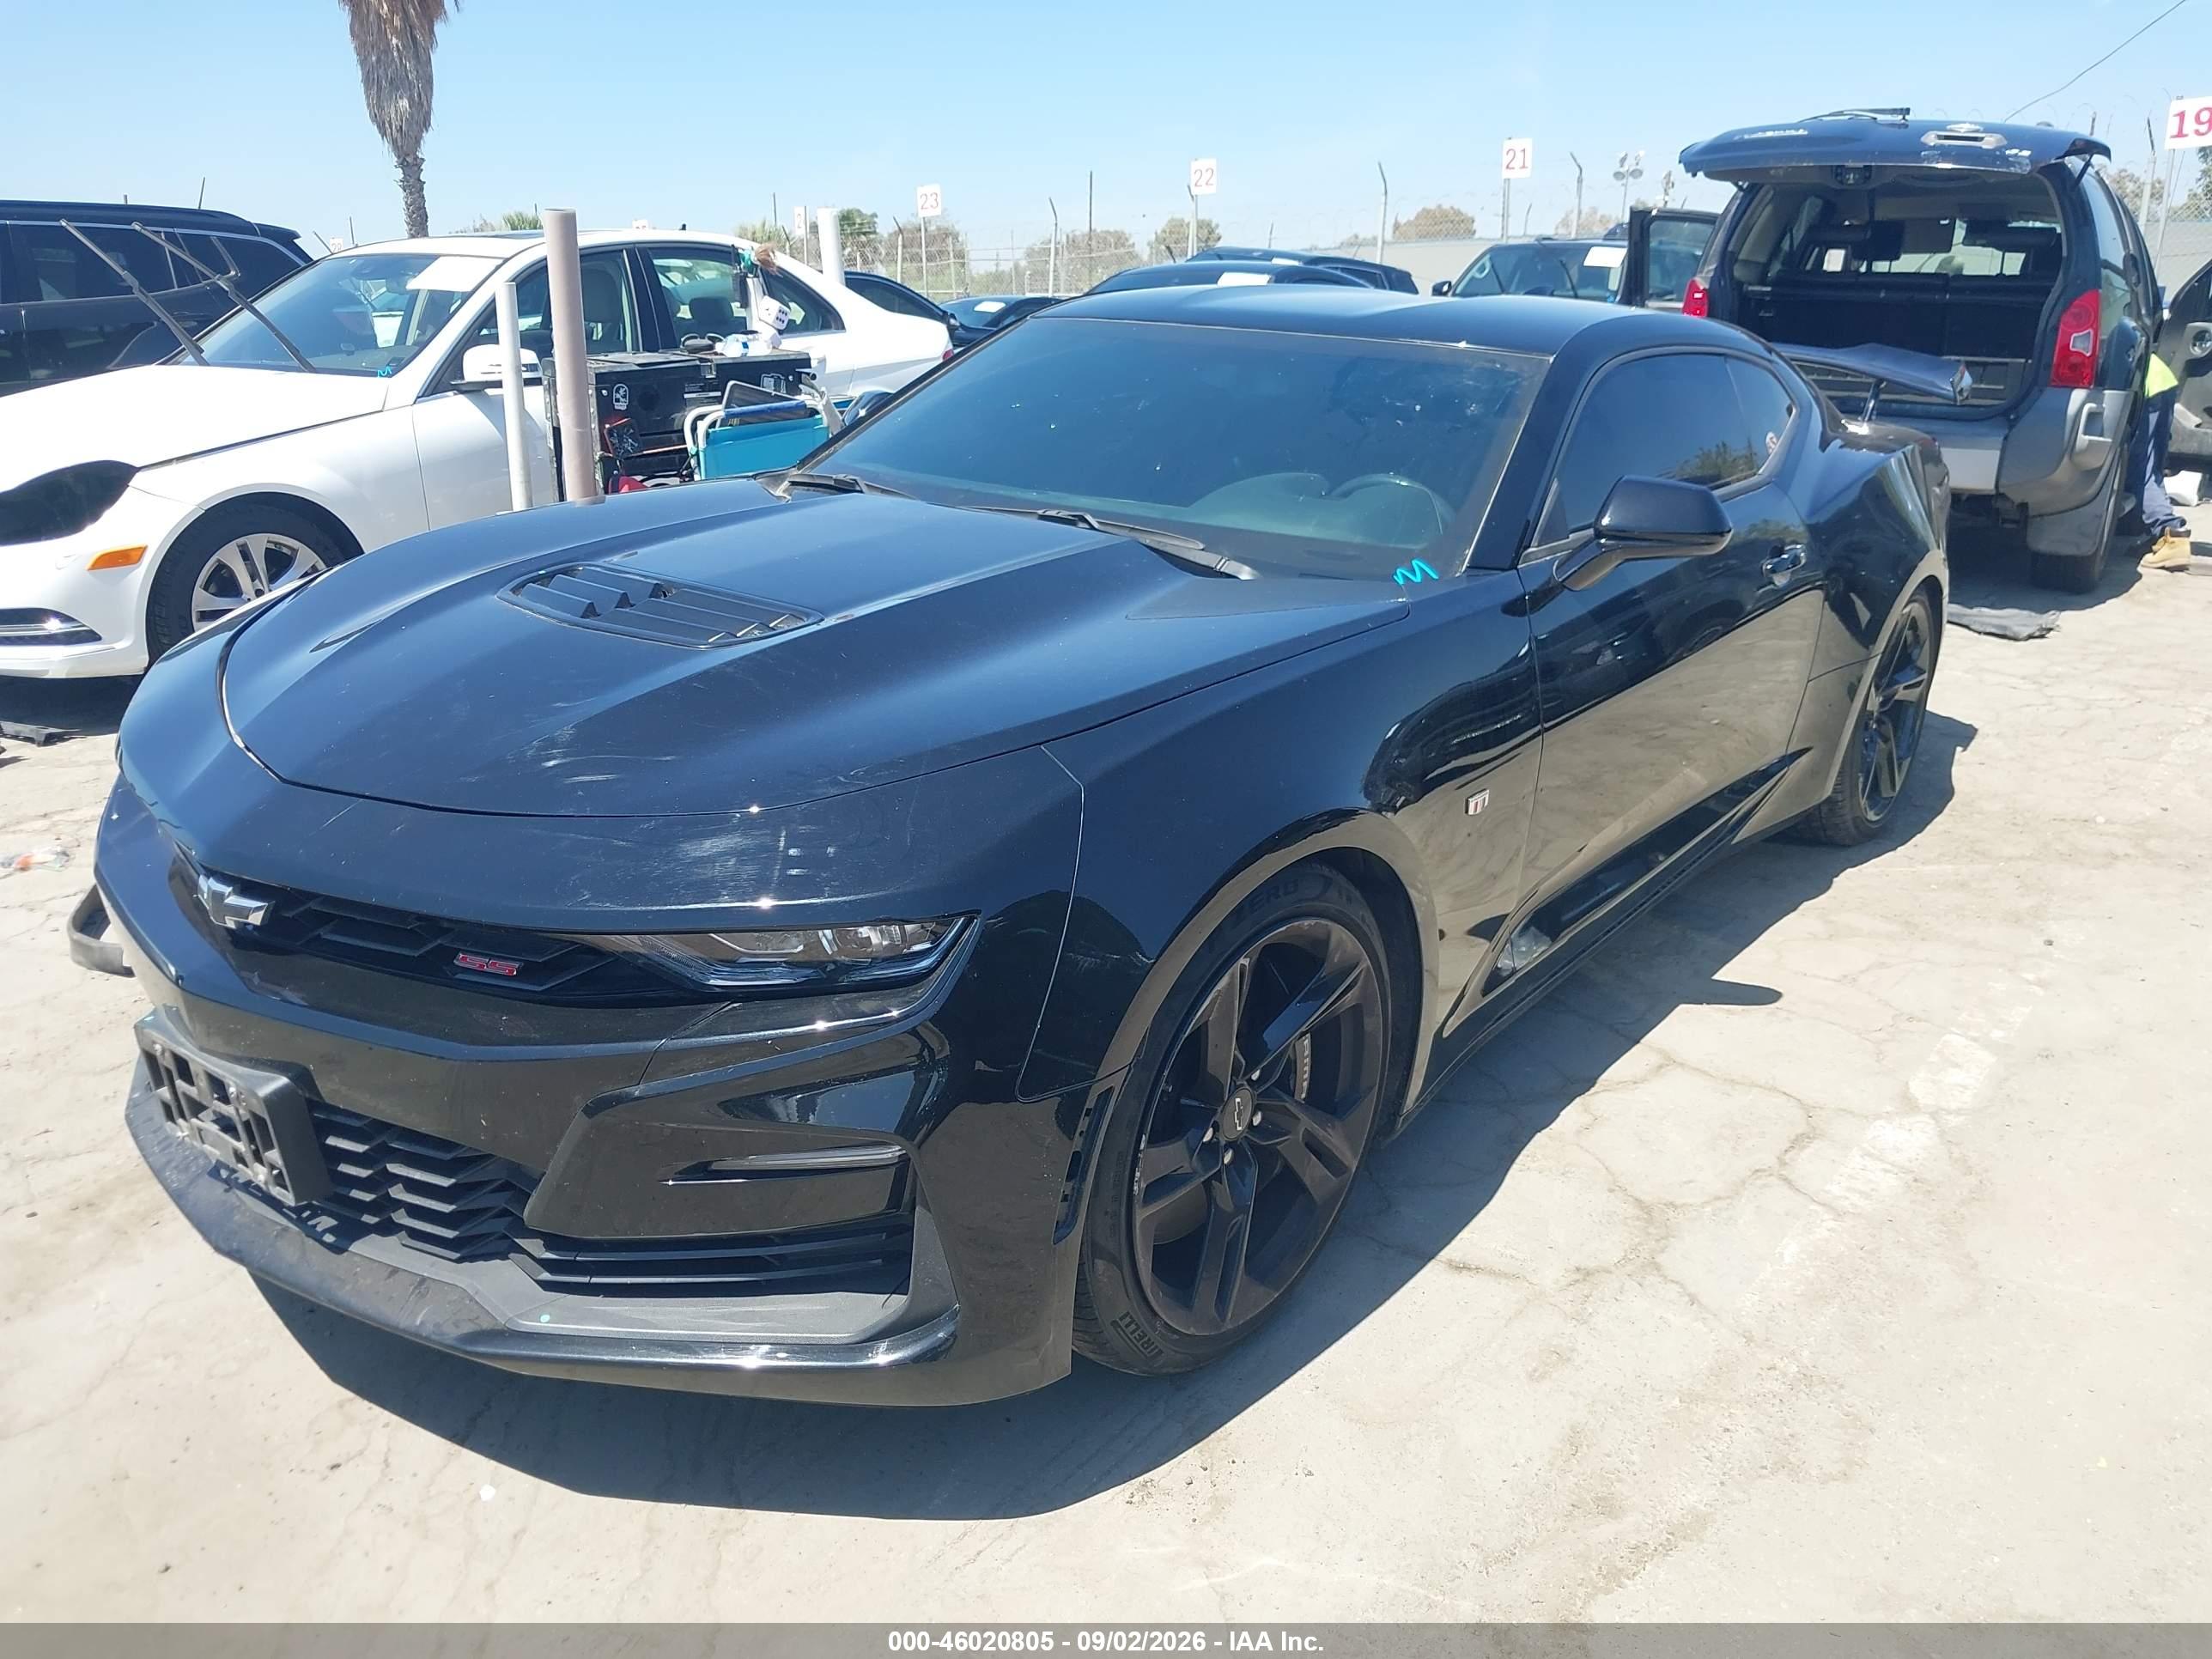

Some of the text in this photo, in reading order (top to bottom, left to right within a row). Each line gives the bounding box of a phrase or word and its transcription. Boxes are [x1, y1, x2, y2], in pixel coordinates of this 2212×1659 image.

[2169, 106, 2212, 139] 19
[1505, 147, 1529, 170] 21
[1194, 167, 1214, 187] 22
[920, 191, 939, 210] 23
[453, 951, 522, 976] SS
